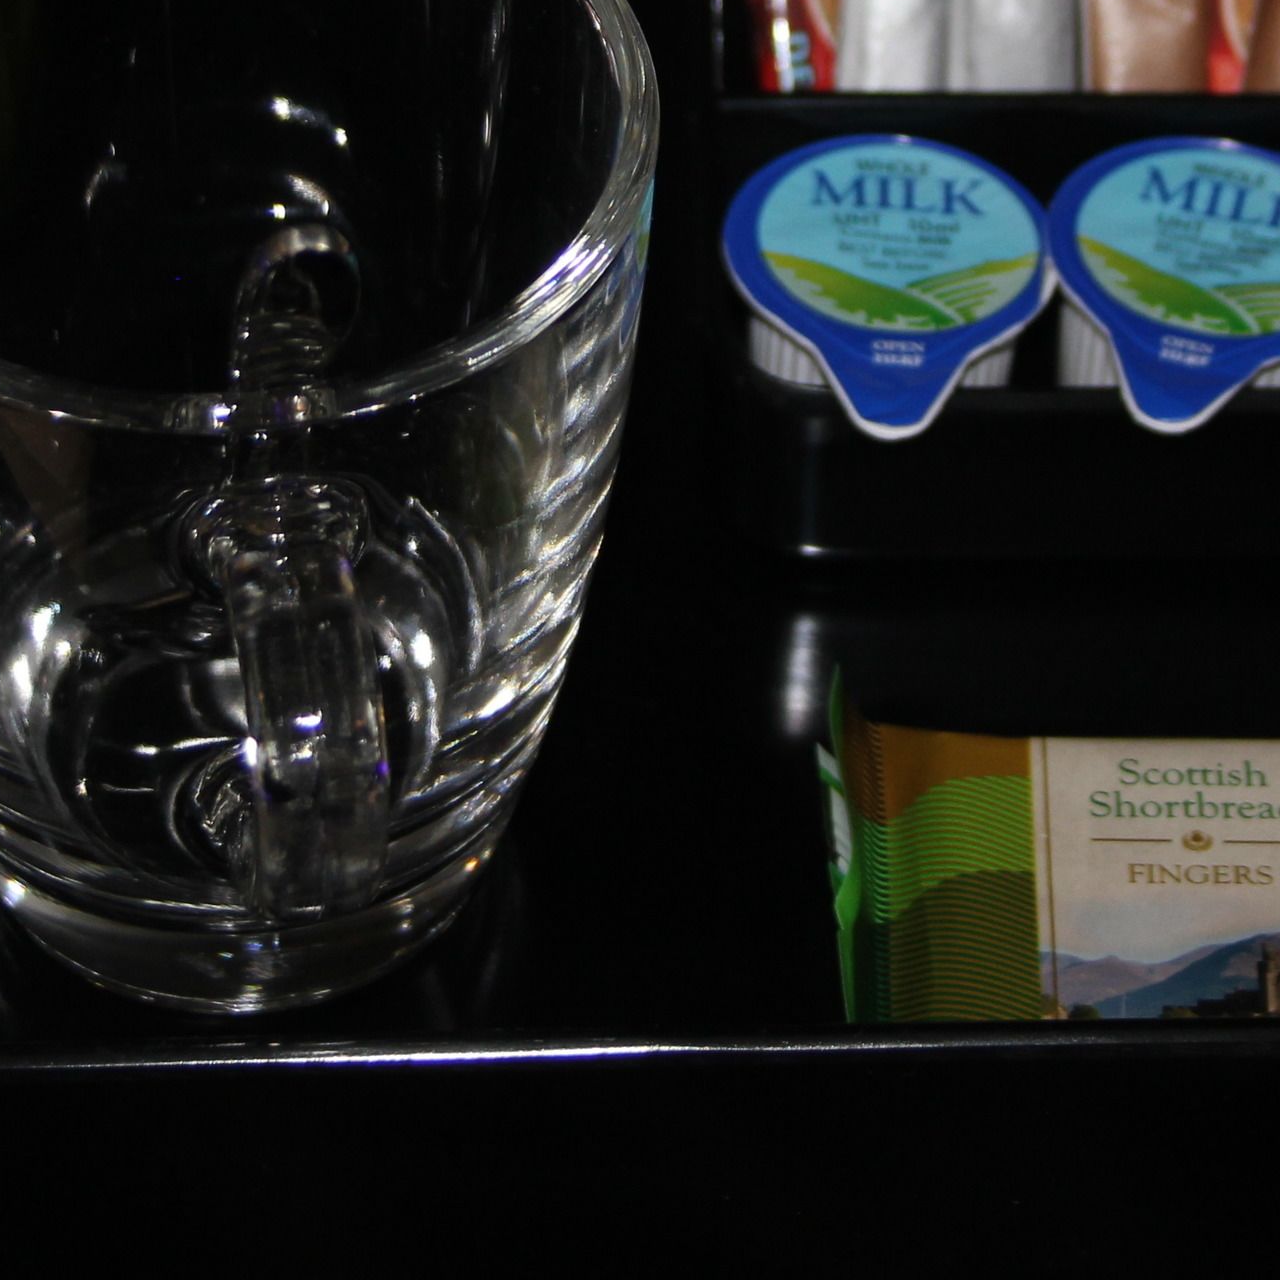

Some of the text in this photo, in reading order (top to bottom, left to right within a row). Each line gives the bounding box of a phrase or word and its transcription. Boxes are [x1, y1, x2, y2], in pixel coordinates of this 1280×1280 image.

[811, 169, 984, 217] MILK
[871, 339, 925, 352] OPEN
[1118, 757, 1269, 788] Scottish
[1126, 862, 1275, 886] FINGERS
